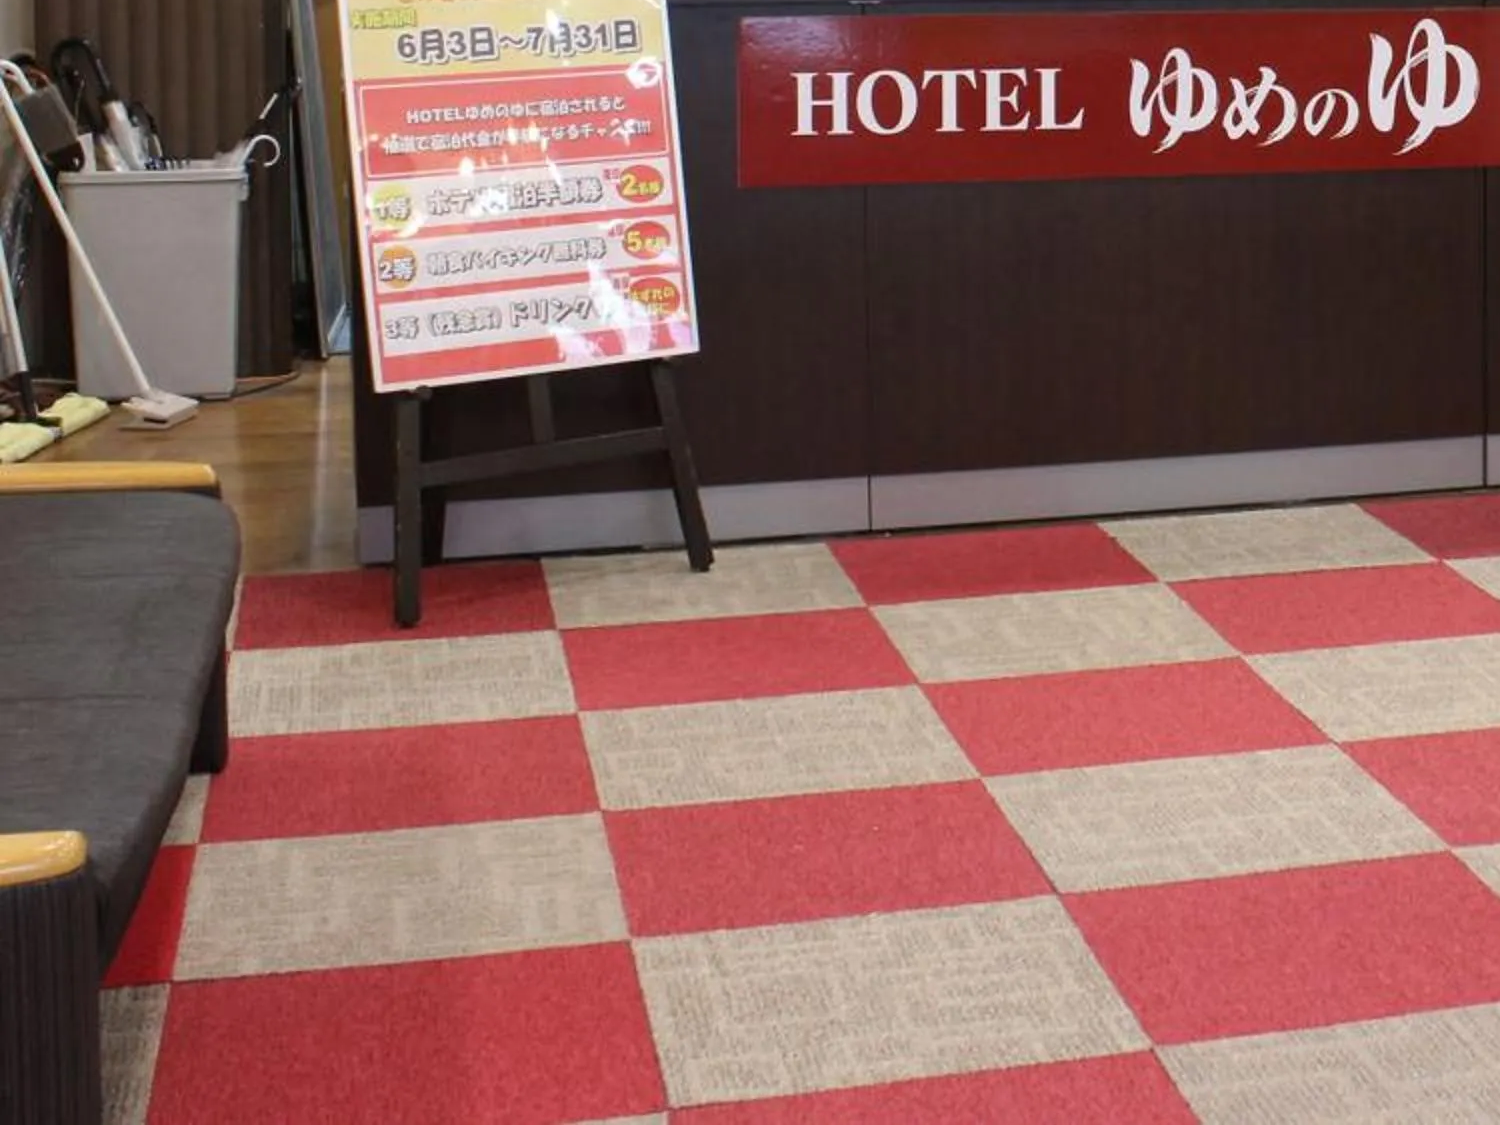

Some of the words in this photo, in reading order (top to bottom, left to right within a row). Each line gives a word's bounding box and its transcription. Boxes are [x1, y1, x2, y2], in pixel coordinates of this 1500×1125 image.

[790, 66, 1085, 136] HOTEL
[1129, 17, 1481, 156] ゆめのゆ
[379, 257, 416, 282] 2等
